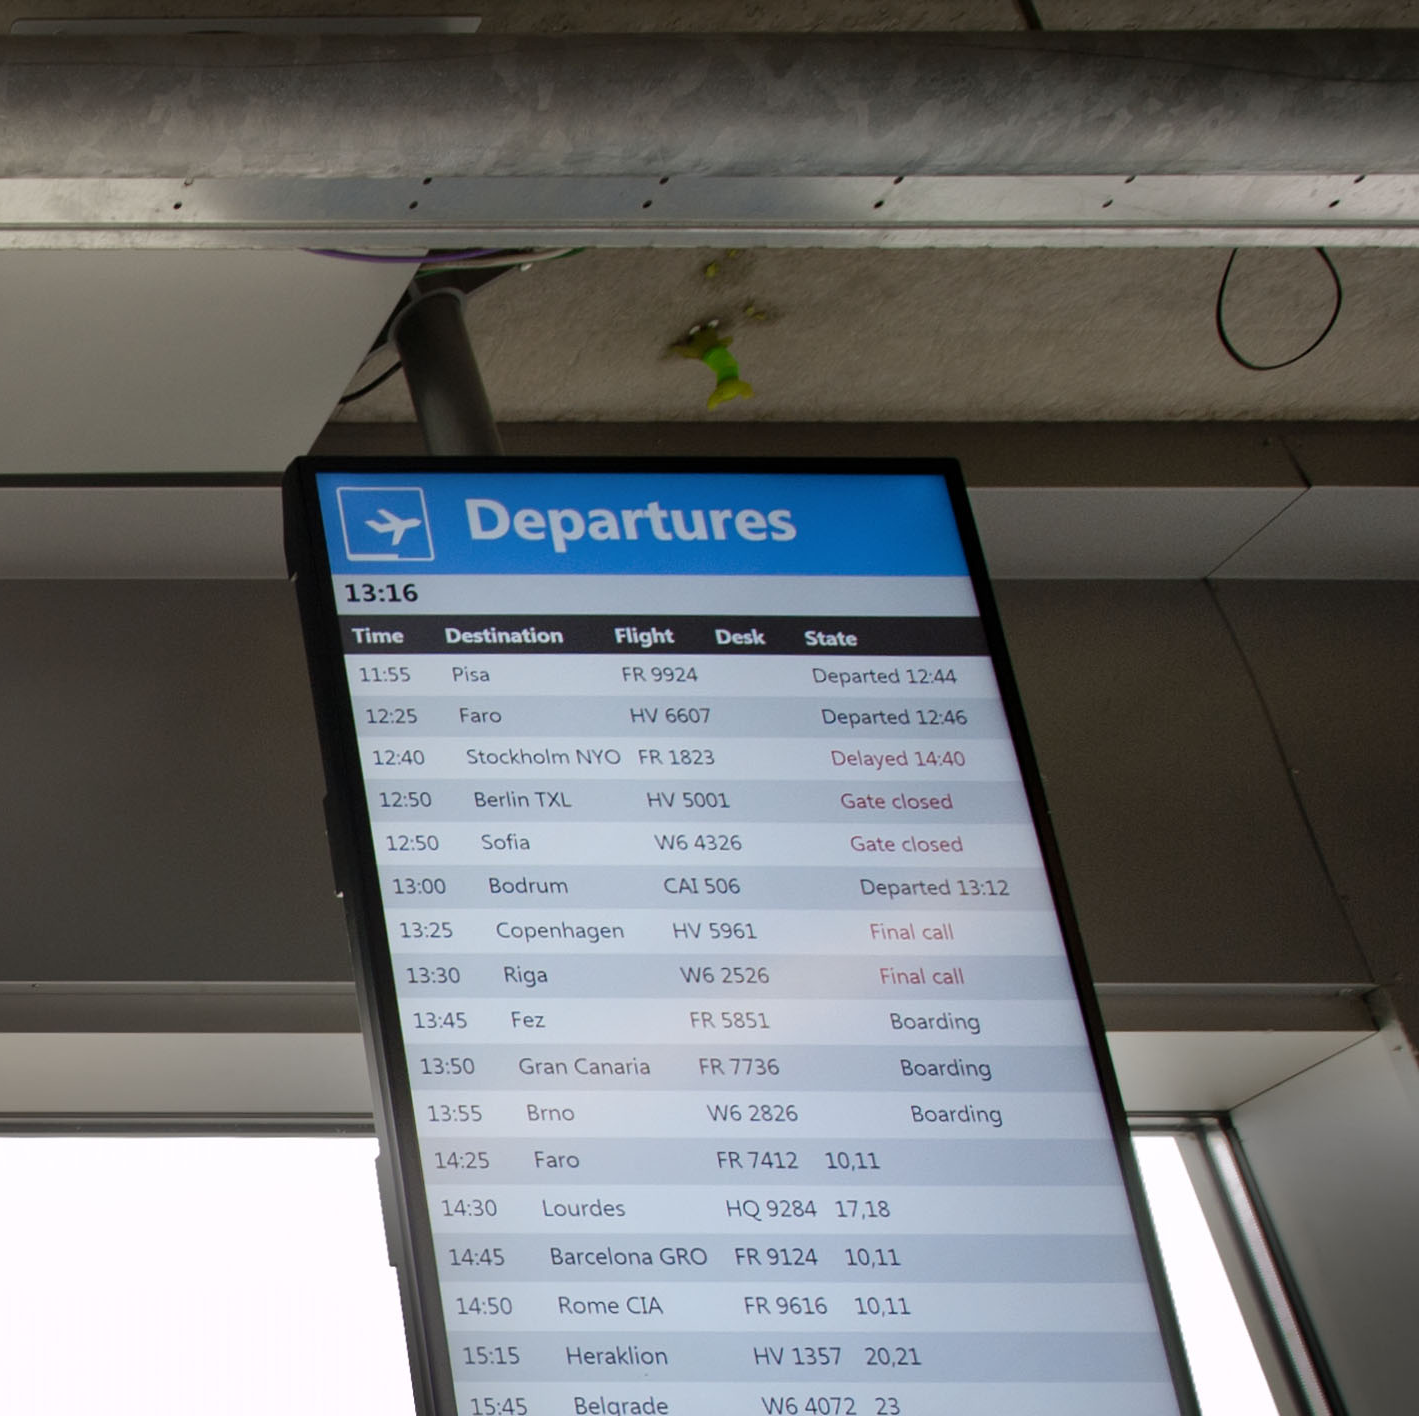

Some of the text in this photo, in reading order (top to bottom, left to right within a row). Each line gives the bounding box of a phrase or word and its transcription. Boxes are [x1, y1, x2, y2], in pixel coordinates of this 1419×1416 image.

[464, 497, 798, 554] Departures
[345, 583, 419, 603] 13:16
[351, 626, 858, 648] Time Destination Flight Desk State
[360, 666, 958, 688] 11:55 Pisa FR 9924 Departed 12:44
[372, 748, 966, 771] 12:40 Stockholm NYO FR 1823 Delayed 14:40
[386, 833, 964, 853] 12:50 Sofia W6 4326 Gate closed
[399, 921, 954, 944] 13:25 Copenhagen HV 5961 Final call
[413, 1010, 981, 1036] 13:45 Fez FR 5851 Boarding
[427, 1103, 1003, 1128] 13:55 Brno W6 2826 Boarding
[441, 1198, 891, 1222] 14:30 Lourdes HQ 9284 17,18
[456, 1295, 912, 1317] 14:50 Rome CIA FR 9616 10,11
[470, 1397, 528, 1416] 15:45
[760, 1396, 799, 1416] W6
[804, 1396, 857, 1416] 4072
[874, 1396, 901, 1416] 23
